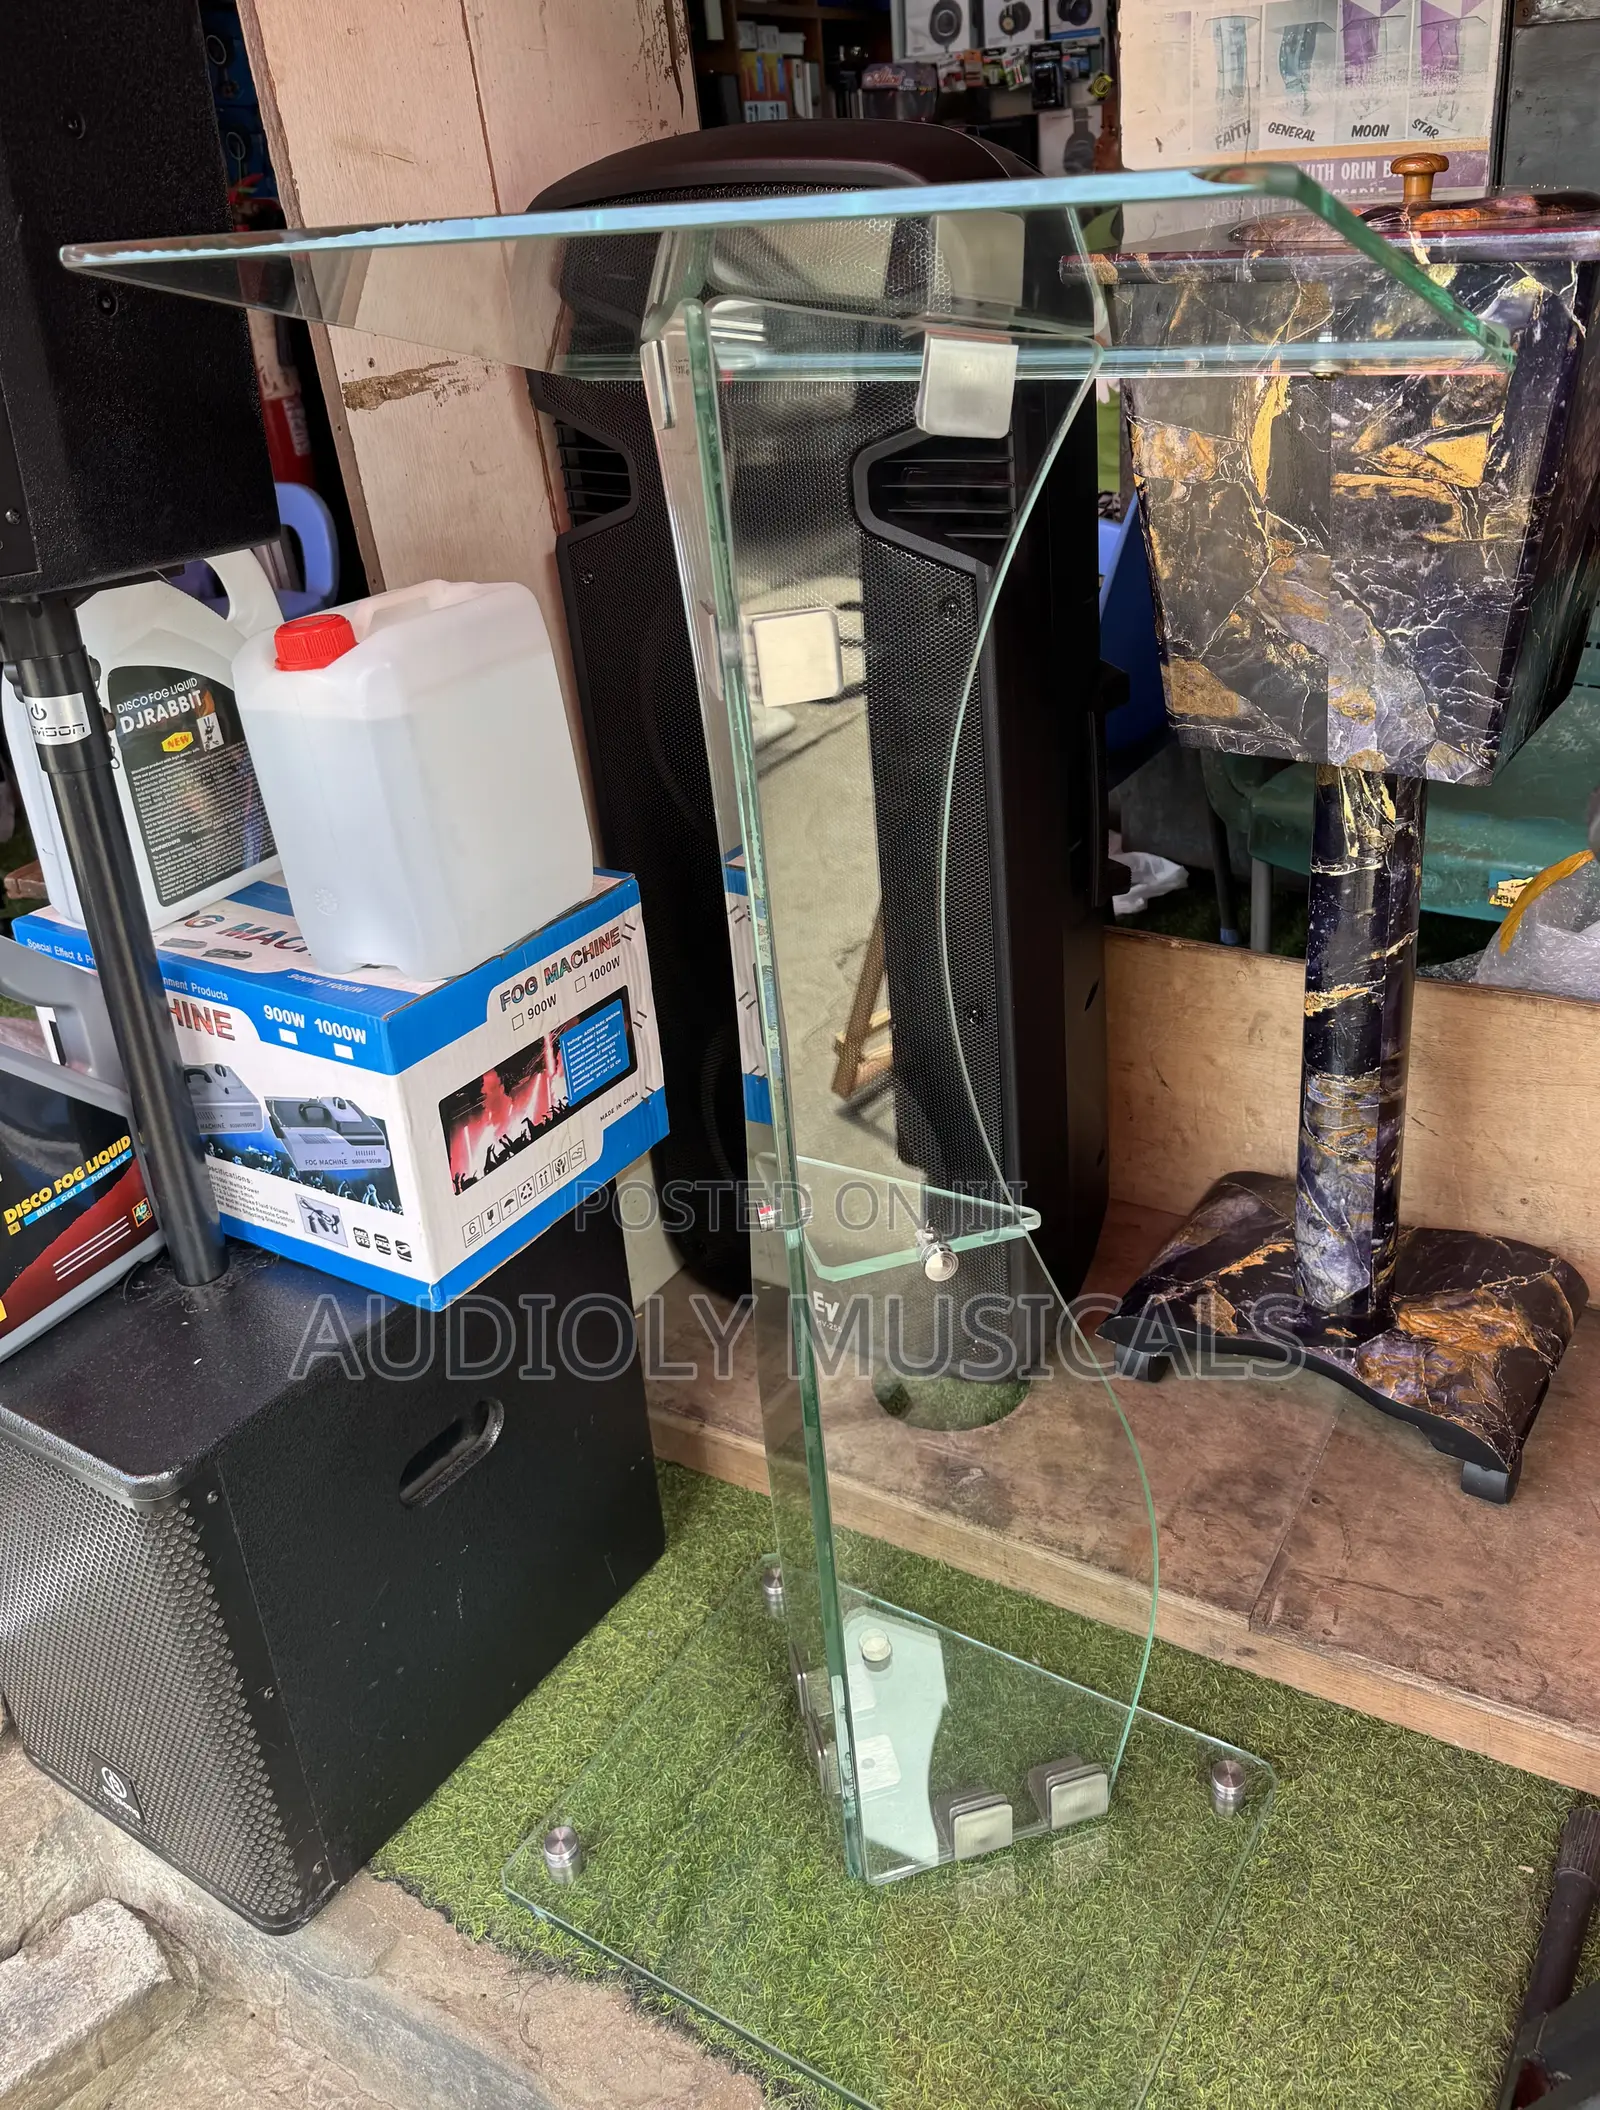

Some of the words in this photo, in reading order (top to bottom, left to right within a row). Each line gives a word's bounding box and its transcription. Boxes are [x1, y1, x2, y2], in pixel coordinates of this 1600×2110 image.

[1215, 120, 1251, 150] FAITH
[1268, 122, 1315, 141] GENERAL
[1351, 124, 1390, 138] MOON
[1412, 118, 1440, 139] STAR
[1341, 161, 1376, 180] ORIN
[116, 696, 149, 714] DISCO
[149, 688, 170, 704] FOG
[169, 677, 198, 695] LIQUID
[167, 734, 190, 749] NEW
[26, 938, 52, 954] Special
[54, 945, 76, 960] Effect
[500, 976, 538, 1012] FOG
[544, 926, 621, 986] MACHINE
[589, 956, 620, 982] 1000W
[191, 982, 228, 1001] Products
[527, 994, 557, 1020] 900W
[263, 1004, 305, 1029] 900W
[314, 1018, 367, 1045] 1000W
[600, 1107, 615, 1121] MADE
[623, 1091, 638, 1105] CHINA
[3, 1187, 52, 1224] DISCO
[54, 1166, 85, 1194] FOG
[85, 1135, 131, 1174] LIQUID
[35, 1202, 56, 1218] Blue
[60, 1189, 77, 1202] cat
[80, 1182, 88, 1190] &
[468, 1222, 477, 1235] 6
